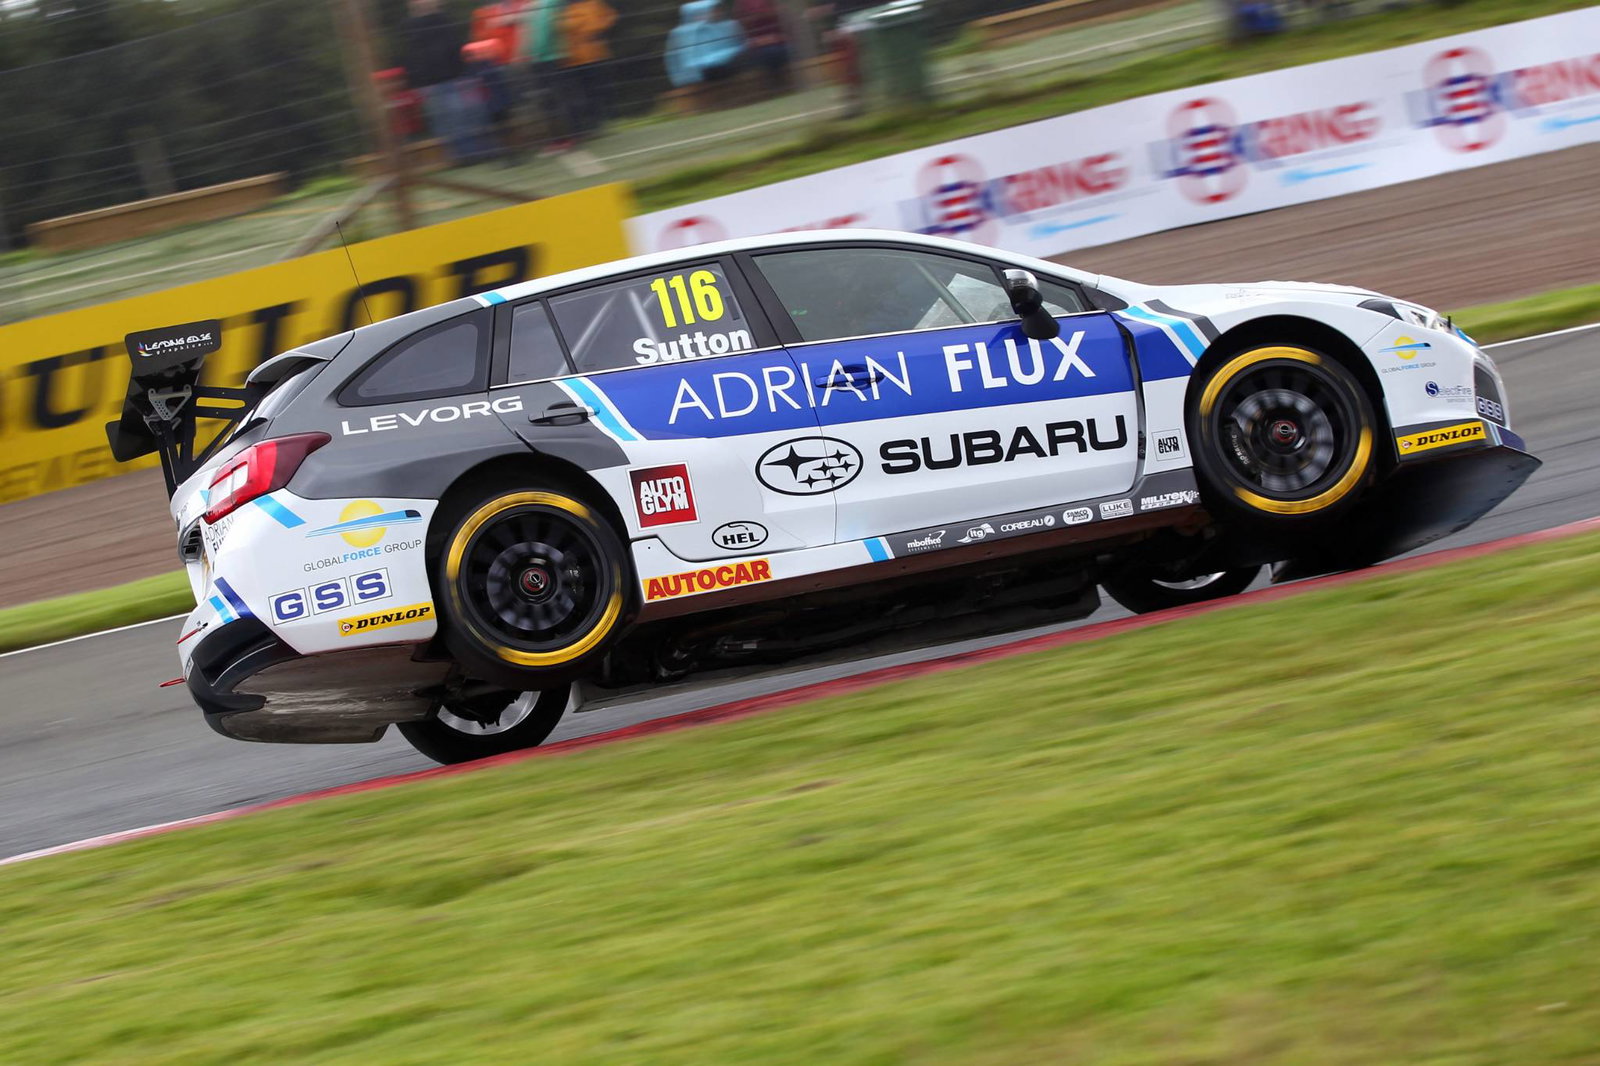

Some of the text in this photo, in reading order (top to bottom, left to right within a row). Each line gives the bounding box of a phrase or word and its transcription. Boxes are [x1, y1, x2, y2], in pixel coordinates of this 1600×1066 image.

[650, 269, 724, 329] 116
[632, 328, 752, 366] Sutton
[668, 330, 1096, 425] ADRIAN FLUX
[341, 395, 523, 436] LEVORG
[879, 414, 1128, 475] SUBARU
[1157, 436, 1178, 447] AUTO
[1416, 426, 1482, 447] DUNLOP
[1158, 444, 1180, 454] GLYM
[639, 476, 686, 499] AUTO
[640, 493, 690, 516] GLYM
[1102, 502, 1130, 512] LUKE
[1000, 518, 1044, 533] CORBEAU
[722, 531, 760, 545] HEL
[303, 539, 422, 573] GLOBALFORCE GROUP
[647, 560, 772, 601] AUTOCAR
[273, 572, 388, 621] GSS
[356, 606, 432, 630] DUNLOP
